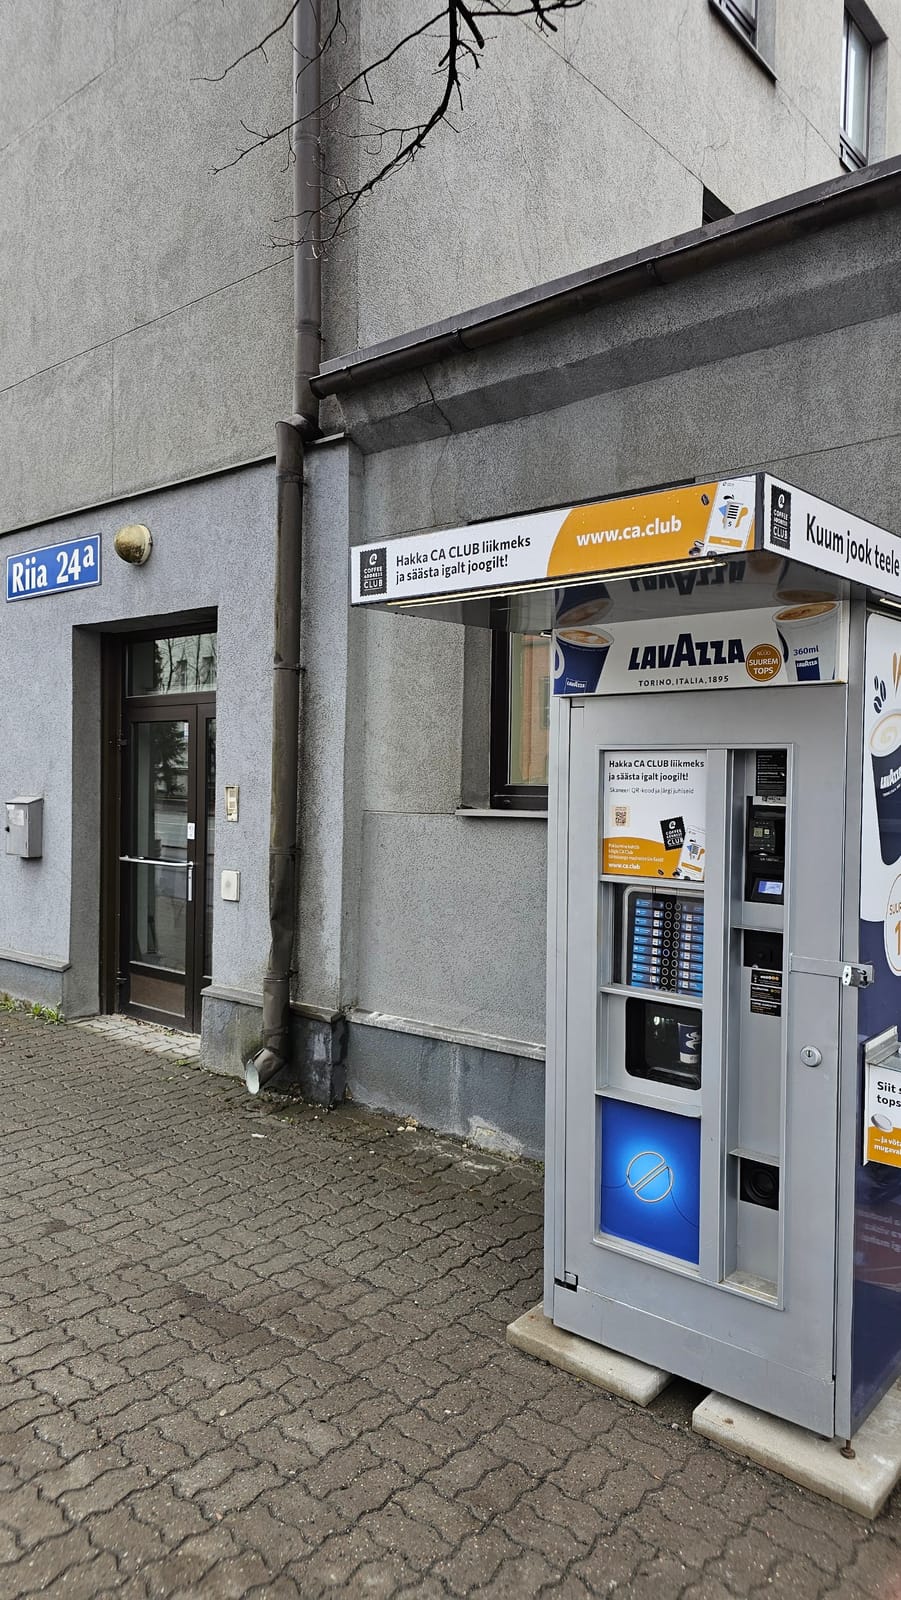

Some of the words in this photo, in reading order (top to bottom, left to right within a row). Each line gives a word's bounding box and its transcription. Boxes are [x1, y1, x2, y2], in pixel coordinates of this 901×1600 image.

[576, 515, 682, 547] www.ca.club
[773, 526, 788, 540] CLUB
[806, 513, 843, 554] Kuum
[846, 530, 872, 566] jook
[874, 544, 900, 576] teele
[396, 552, 428, 567] Hakka
[430, 550, 446, 561] CA
[448, 543, 480, 558] CLUB
[482, 535, 531, 554] liikmeks
[12, 556, 48, 593] Riia
[56, 544, 95, 584] 24a
[364, 566, 382, 574] COFFEE
[396, 570, 404, 585] ja
[406, 566, 440, 582] säästa
[441, 564, 466, 578] igalt
[467, 554, 508, 574] joogilt!
[364, 579, 383, 589] CLUB
[628, 633, 745, 670] LAVAZZA
[793, 645, 819, 656] 360ml
[749, 658, 778, 666] SUUREM
[753, 666, 773, 674] TOPS
[608, 773, 615, 782] ja
[641, 773, 658, 781] igalt
[660, 773, 688, 782] joogilt!
[667, 837, 684, 845] CLUB
[877, 1081, 896, 1093] Siit
